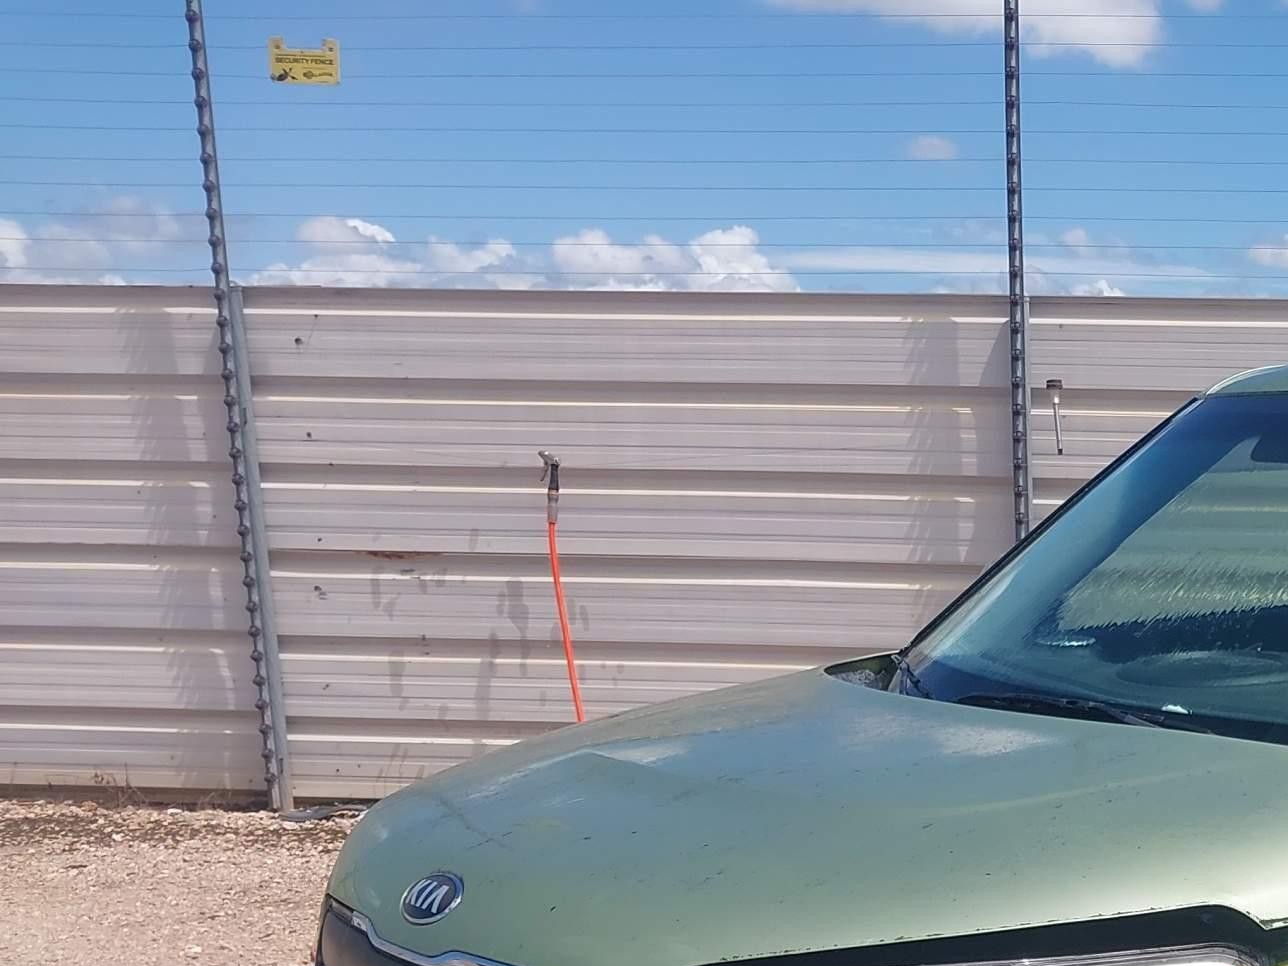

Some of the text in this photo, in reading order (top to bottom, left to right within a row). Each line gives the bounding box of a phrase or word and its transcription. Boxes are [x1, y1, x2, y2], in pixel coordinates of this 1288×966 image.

[275, 57, 335, 66] SECURITY FENCE
[405, 879, 450, 914] KIA
